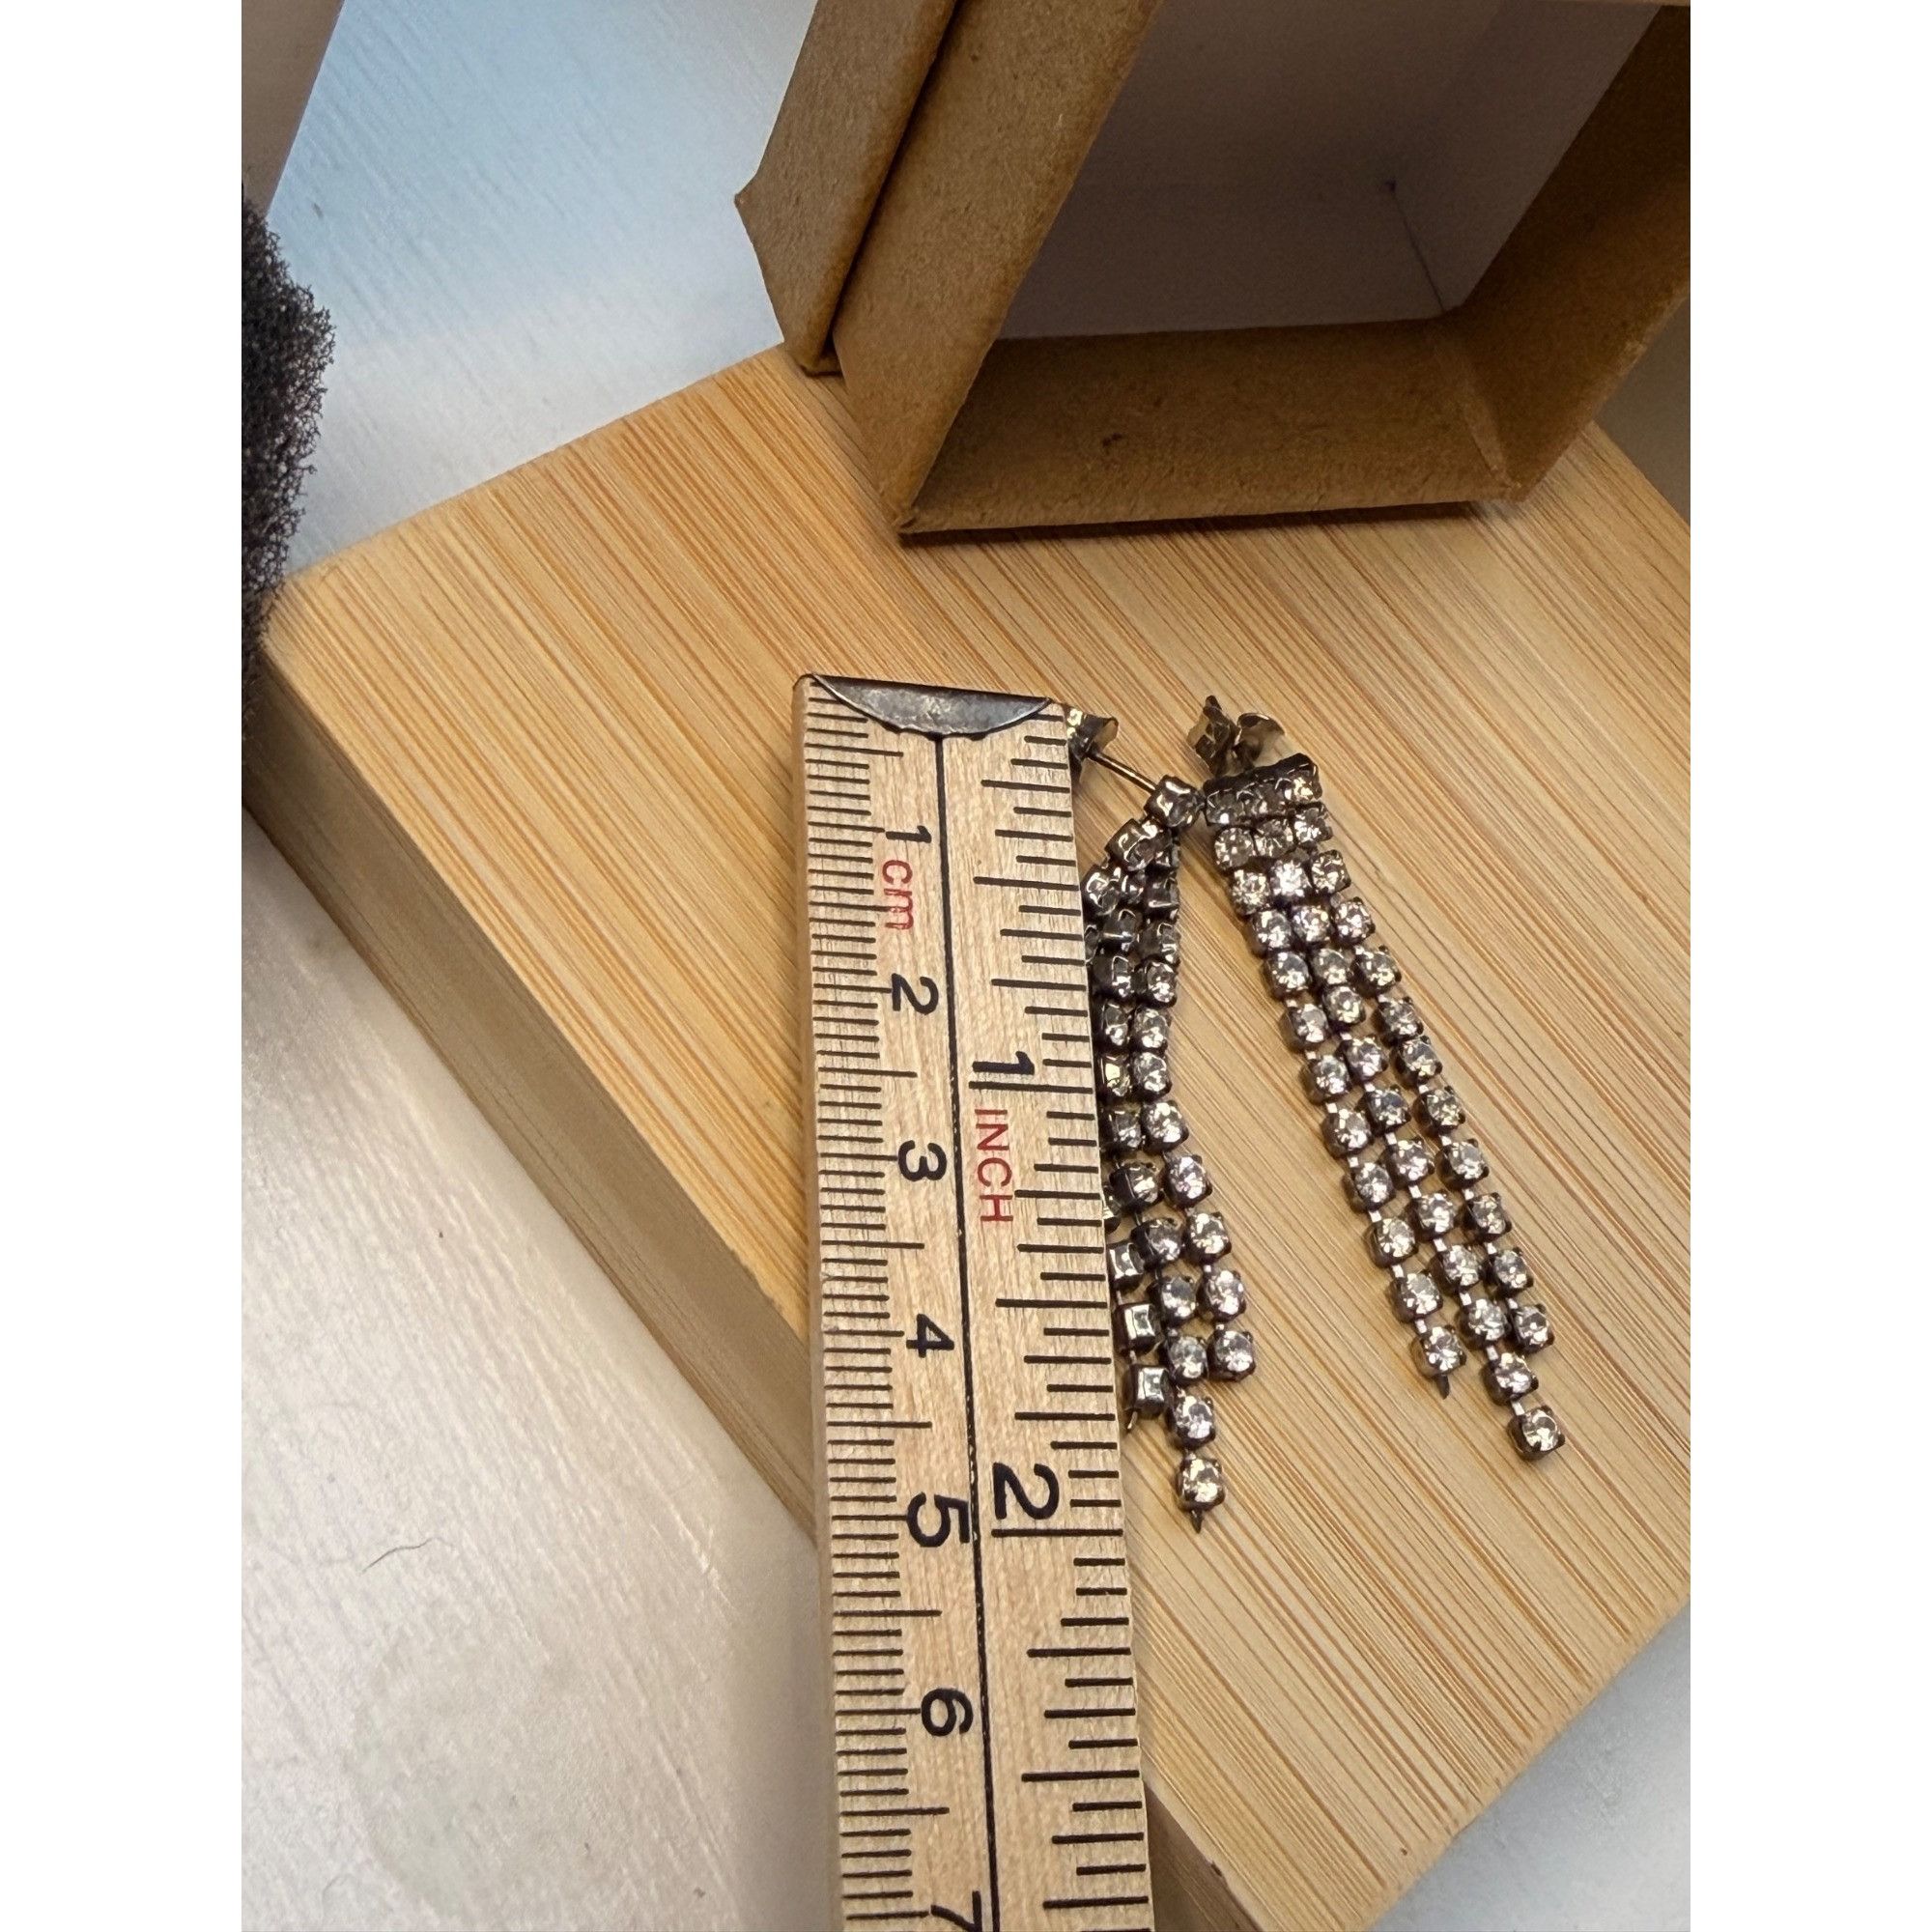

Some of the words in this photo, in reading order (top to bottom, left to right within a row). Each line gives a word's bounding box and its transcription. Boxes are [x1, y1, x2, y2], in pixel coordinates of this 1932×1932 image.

[885, 824, 933, 844] 1
[881, 858, 915, 931] cm
[890, 972, 940, 1016] 2
[972, 1050, 1036, 1076] 1
[897, 1140, 948, 1182] 3
[974, 1108, 1014, 1223] INCH
[905, 1313, 955, 1358] 4
[992, 1462, 1060, 1520] 2
[906, 1492, 971, 1547] 5
[920, 1687, 974, 1738] 6
[930, 1890, 982, 1932] 7
